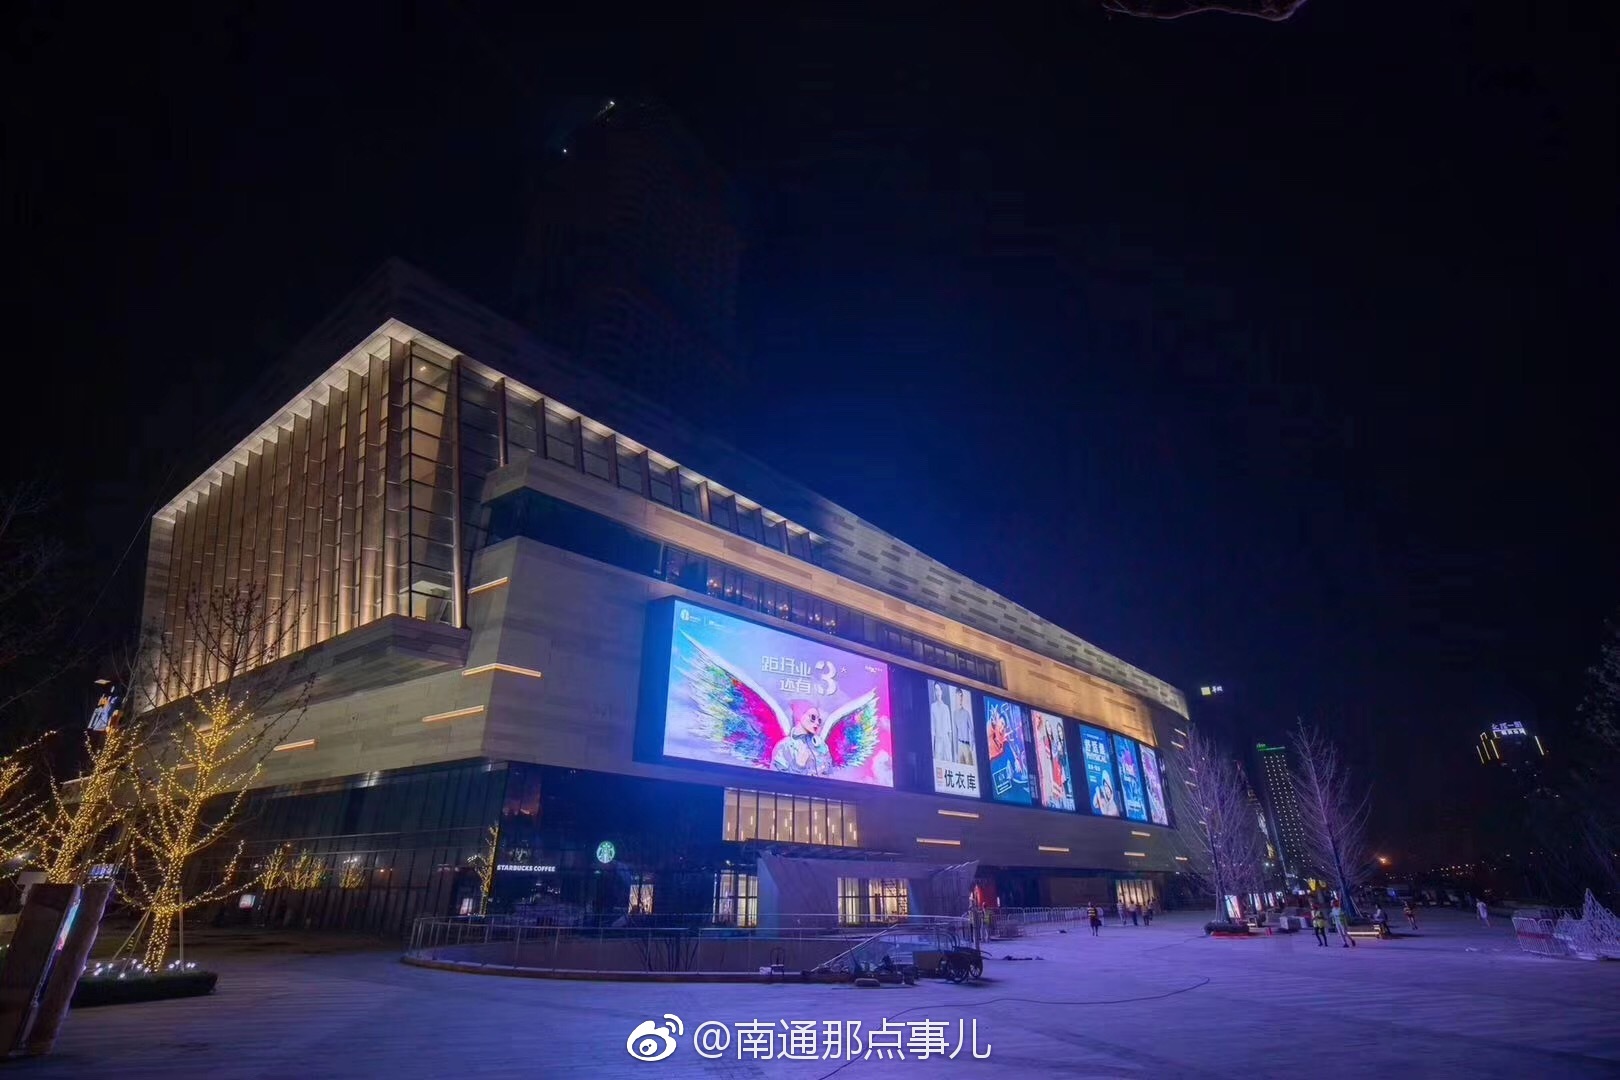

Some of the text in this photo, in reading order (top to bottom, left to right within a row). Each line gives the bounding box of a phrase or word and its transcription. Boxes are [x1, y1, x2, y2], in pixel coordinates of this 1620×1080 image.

[815, 660, 837, 696] 3
[944, 768, 976, 791] 优衣库
